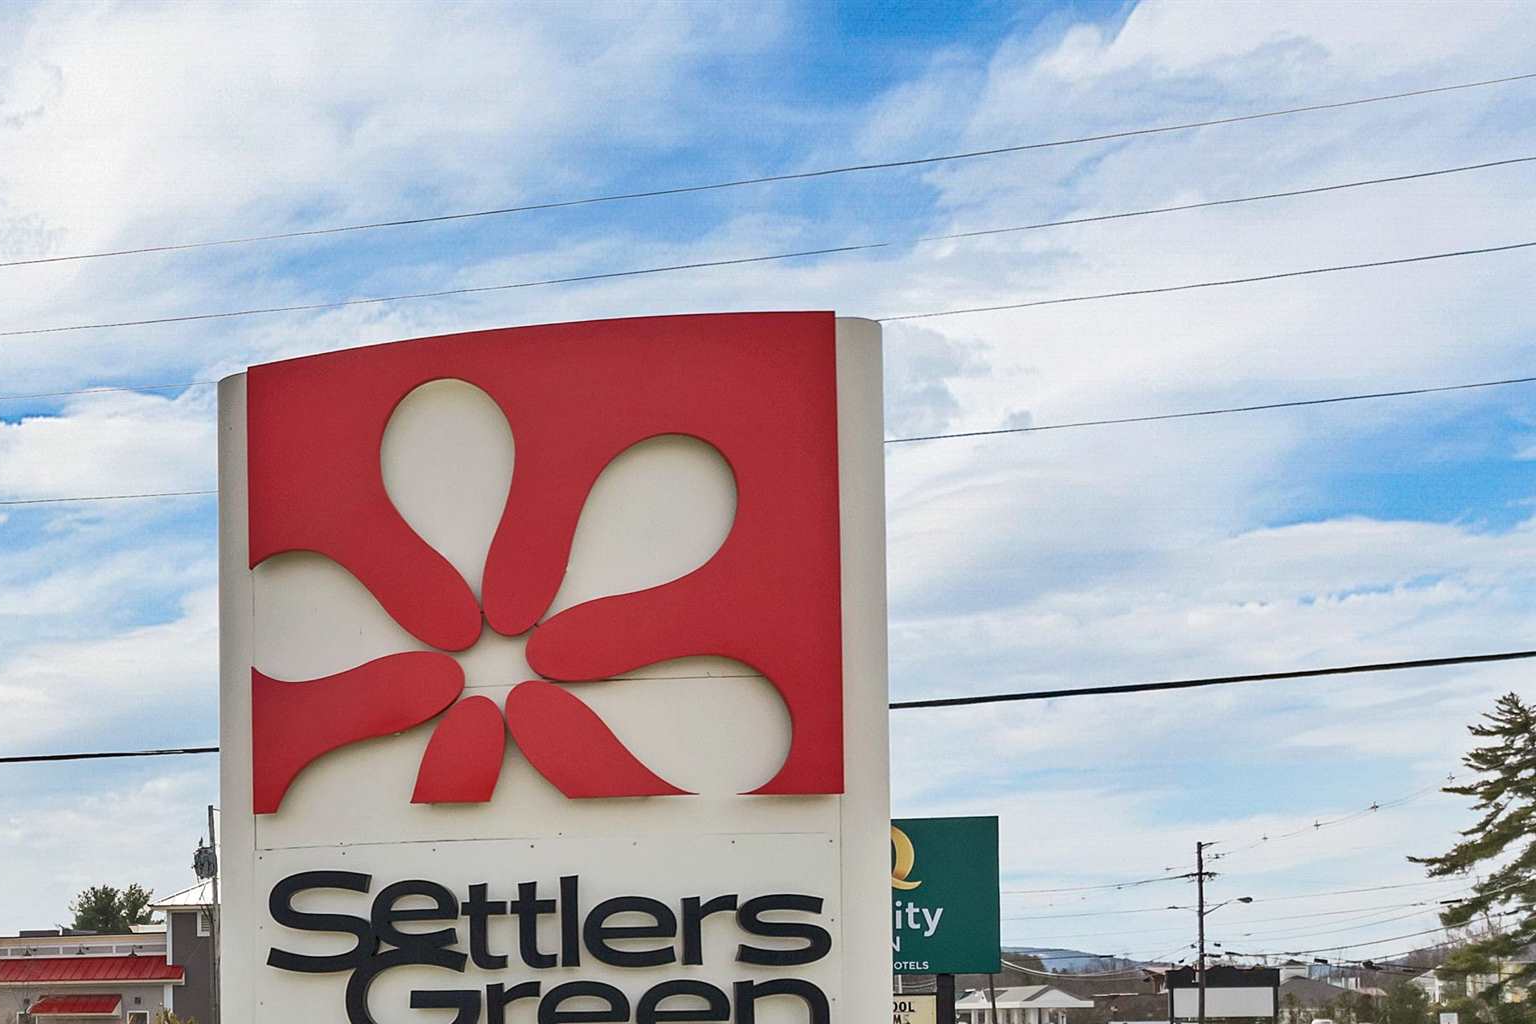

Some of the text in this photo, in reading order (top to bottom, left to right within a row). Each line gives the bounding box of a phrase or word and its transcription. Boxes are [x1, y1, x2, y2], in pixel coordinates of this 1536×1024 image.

[266, 870, 833, 974] Settlers
[895, 900, 944, 937] ity
[893, 961, 929, 970] OTELS
